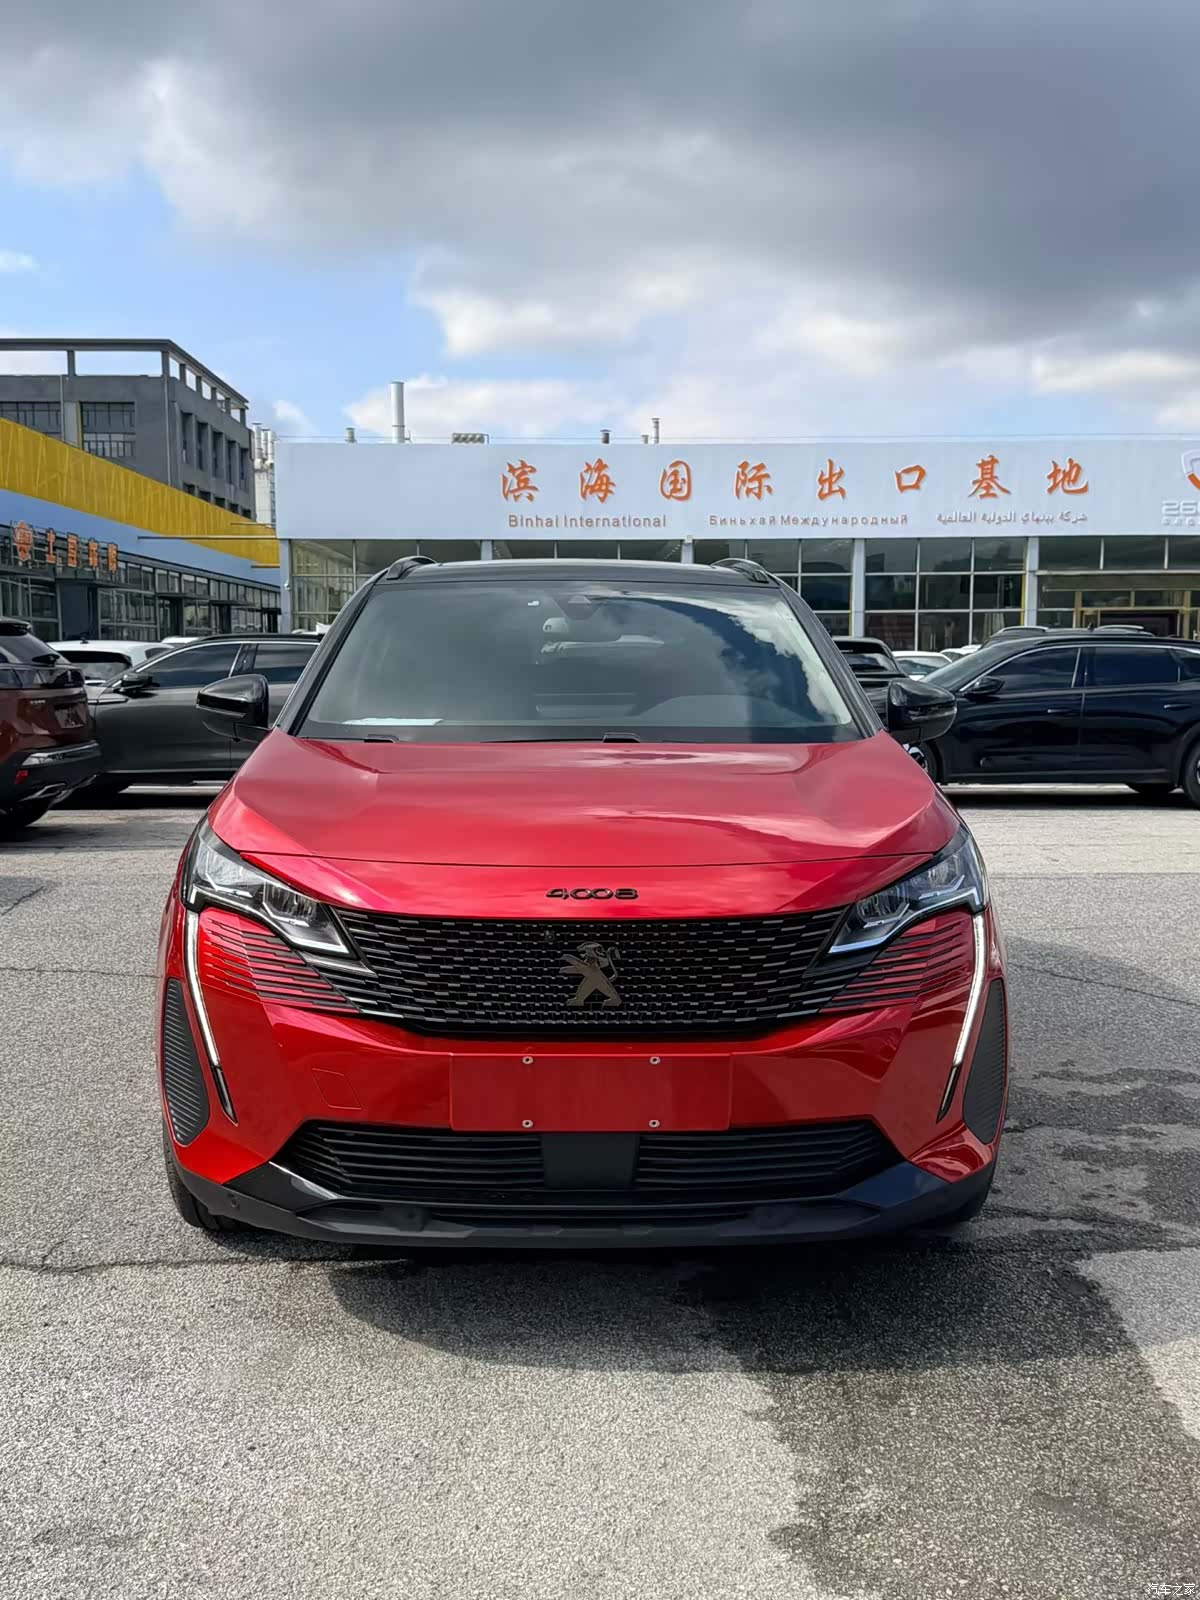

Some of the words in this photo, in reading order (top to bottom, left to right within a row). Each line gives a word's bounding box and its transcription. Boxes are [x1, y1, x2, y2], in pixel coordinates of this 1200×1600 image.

[501, 454, 1089, 503] 滨海国际出口基地
[508, 515, 559, 528] Binhai
[564, 515, 667, 528] International
[709, 515, 776, 526] Биньхай
[780, 514, 908, 527] Международный
[545, 888, 639, 900] 4008
